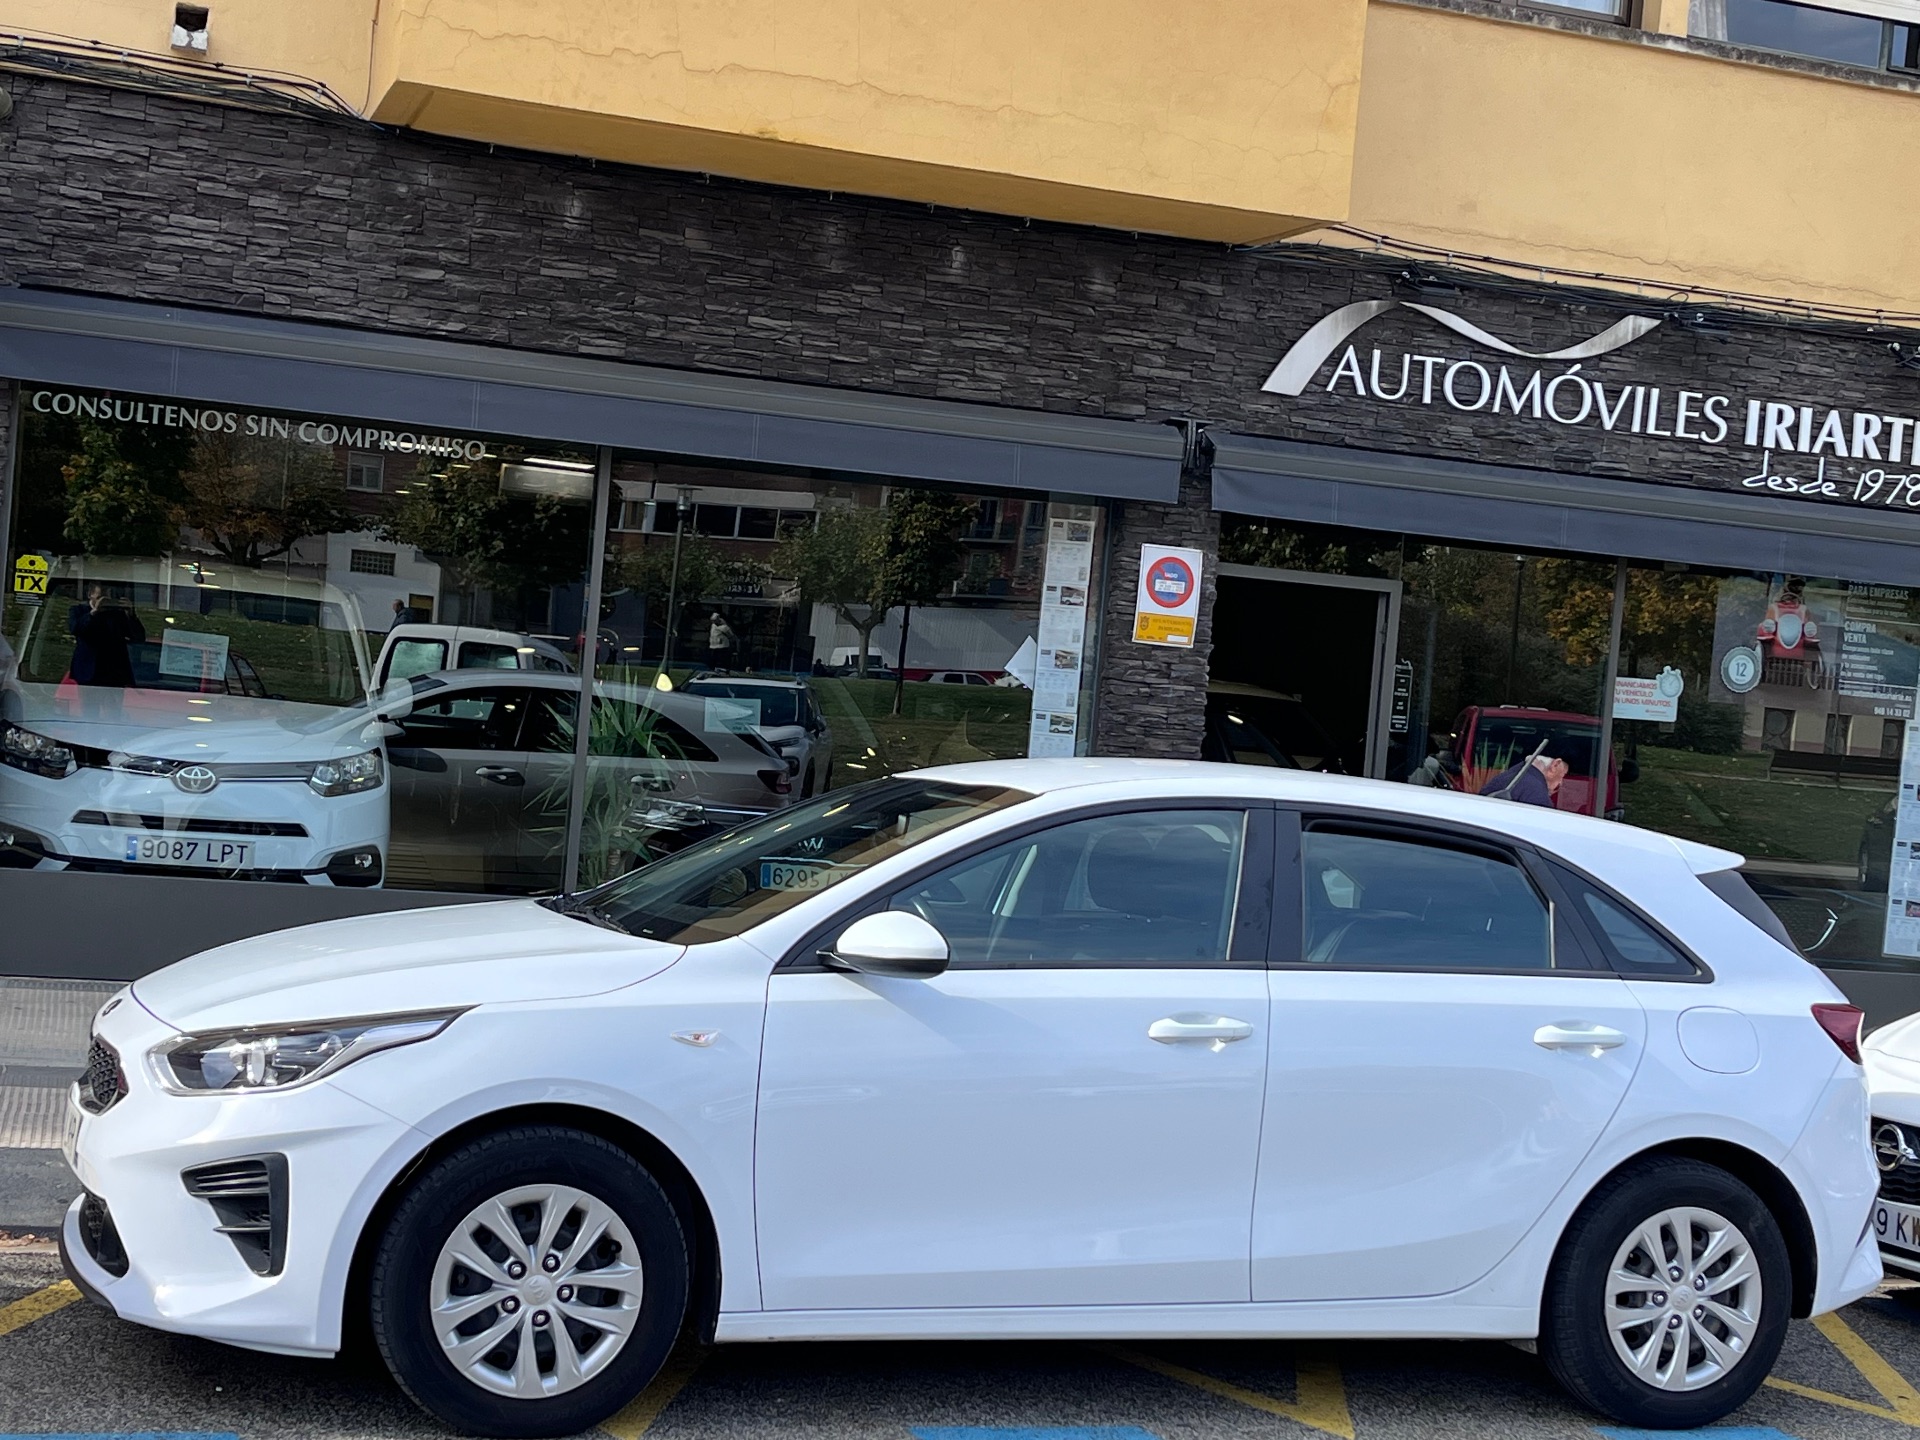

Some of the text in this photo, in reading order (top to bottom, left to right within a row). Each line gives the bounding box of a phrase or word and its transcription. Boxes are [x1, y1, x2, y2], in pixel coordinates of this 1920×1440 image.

[1326, 344, 1730, 443] AUTOMÓVILES
[32, 391, 487, 461] CONSULTENOS SIN COMPROMISO
[1742, 449, 1840, 497] desde
[26, 575, 44, 592] TX
[1843, 632, 1867, 644] VENTA
[1844, 621, 1877, 634] COMPRA
[1735, 662, 1748, 677] 12
[142, 839, 249, 864] 9087 LPT
[772, 867, 820, 889] 6295
